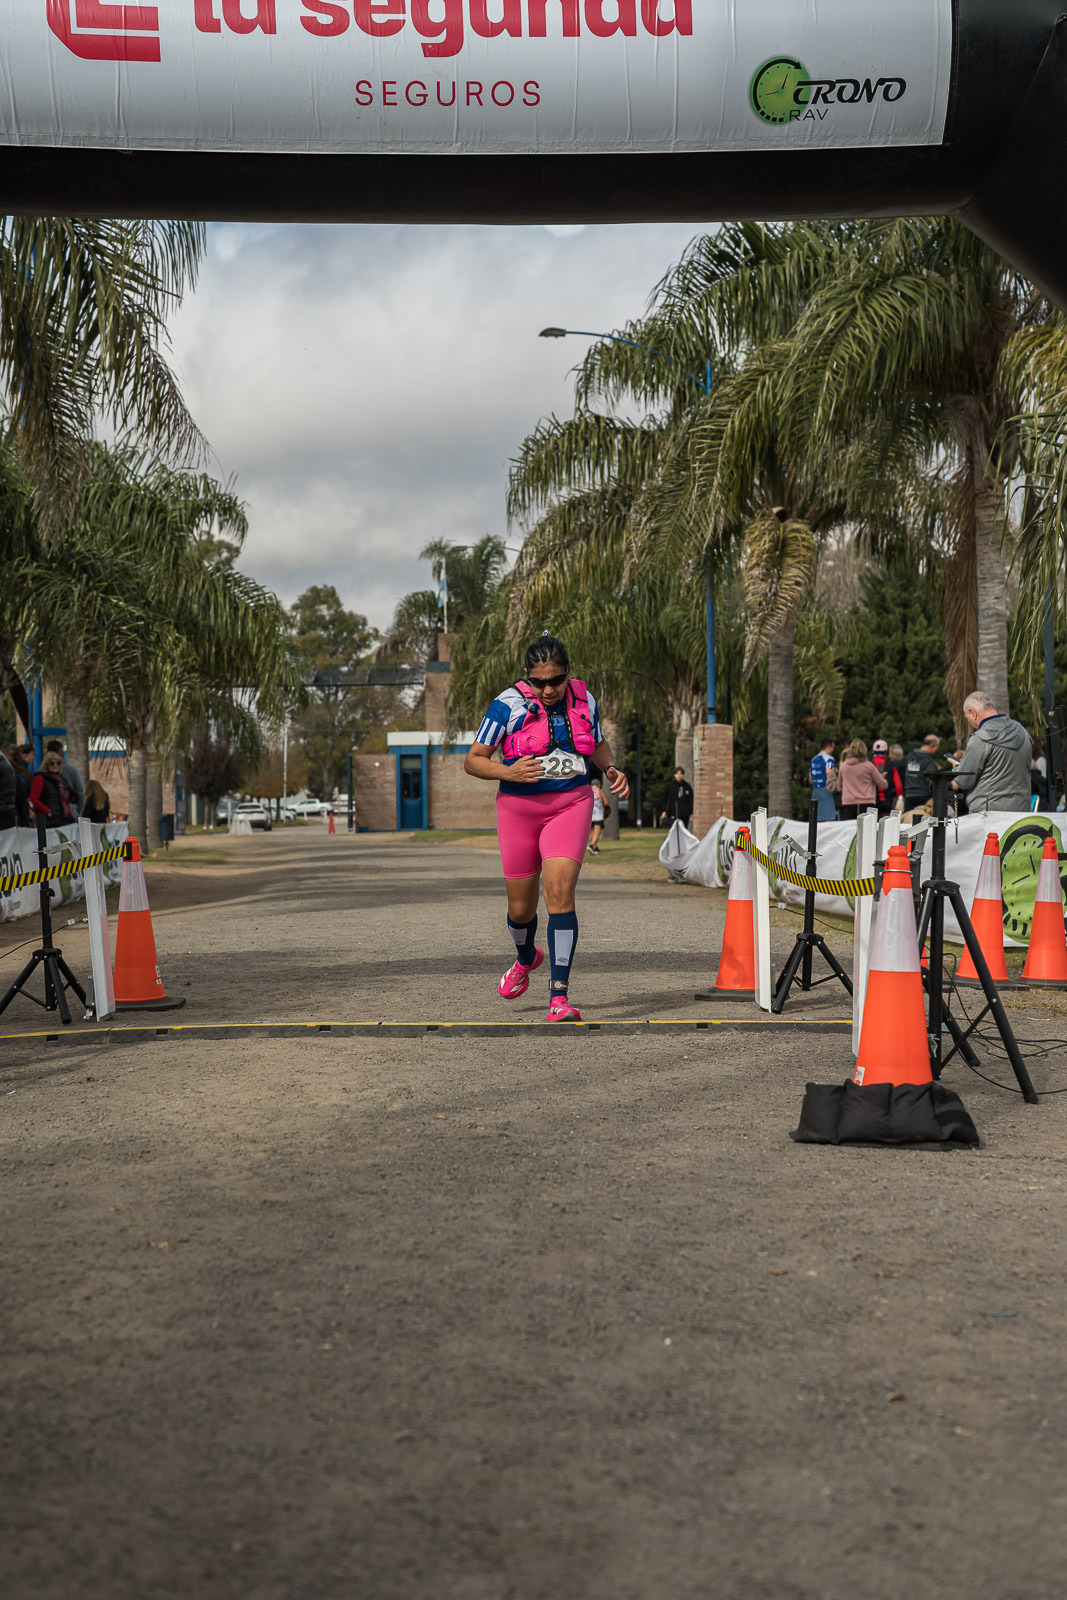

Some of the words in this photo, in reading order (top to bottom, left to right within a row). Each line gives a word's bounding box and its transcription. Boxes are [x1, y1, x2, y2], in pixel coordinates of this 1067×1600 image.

[355, 80, 541, 106] SEGUROS
[793, 78, 906, 104] CRONO
[789, 109, 829, 121] RAV
[547, 757, 574, 775] 28
